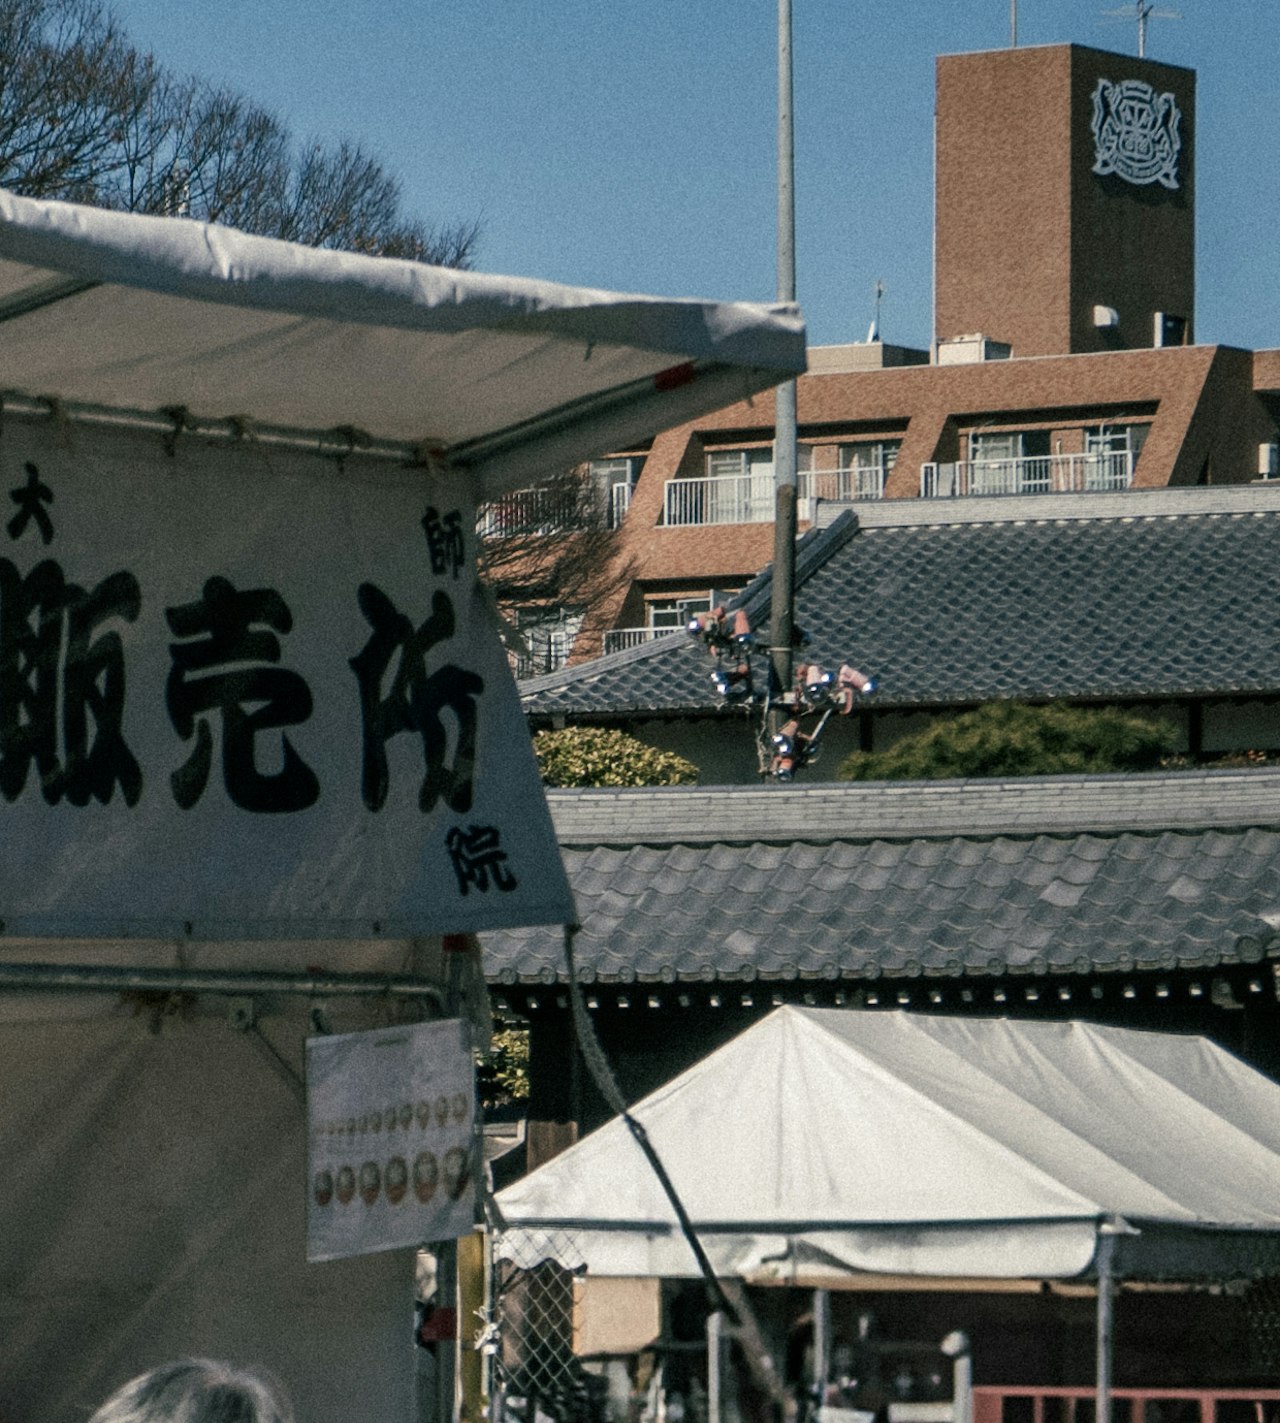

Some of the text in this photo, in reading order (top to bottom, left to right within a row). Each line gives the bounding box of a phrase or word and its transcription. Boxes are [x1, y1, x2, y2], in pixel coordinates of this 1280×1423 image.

[6, 461, 56, 546] 大
[420, 506, 466, 581] 師
[445, 825, 519, 897] 院
